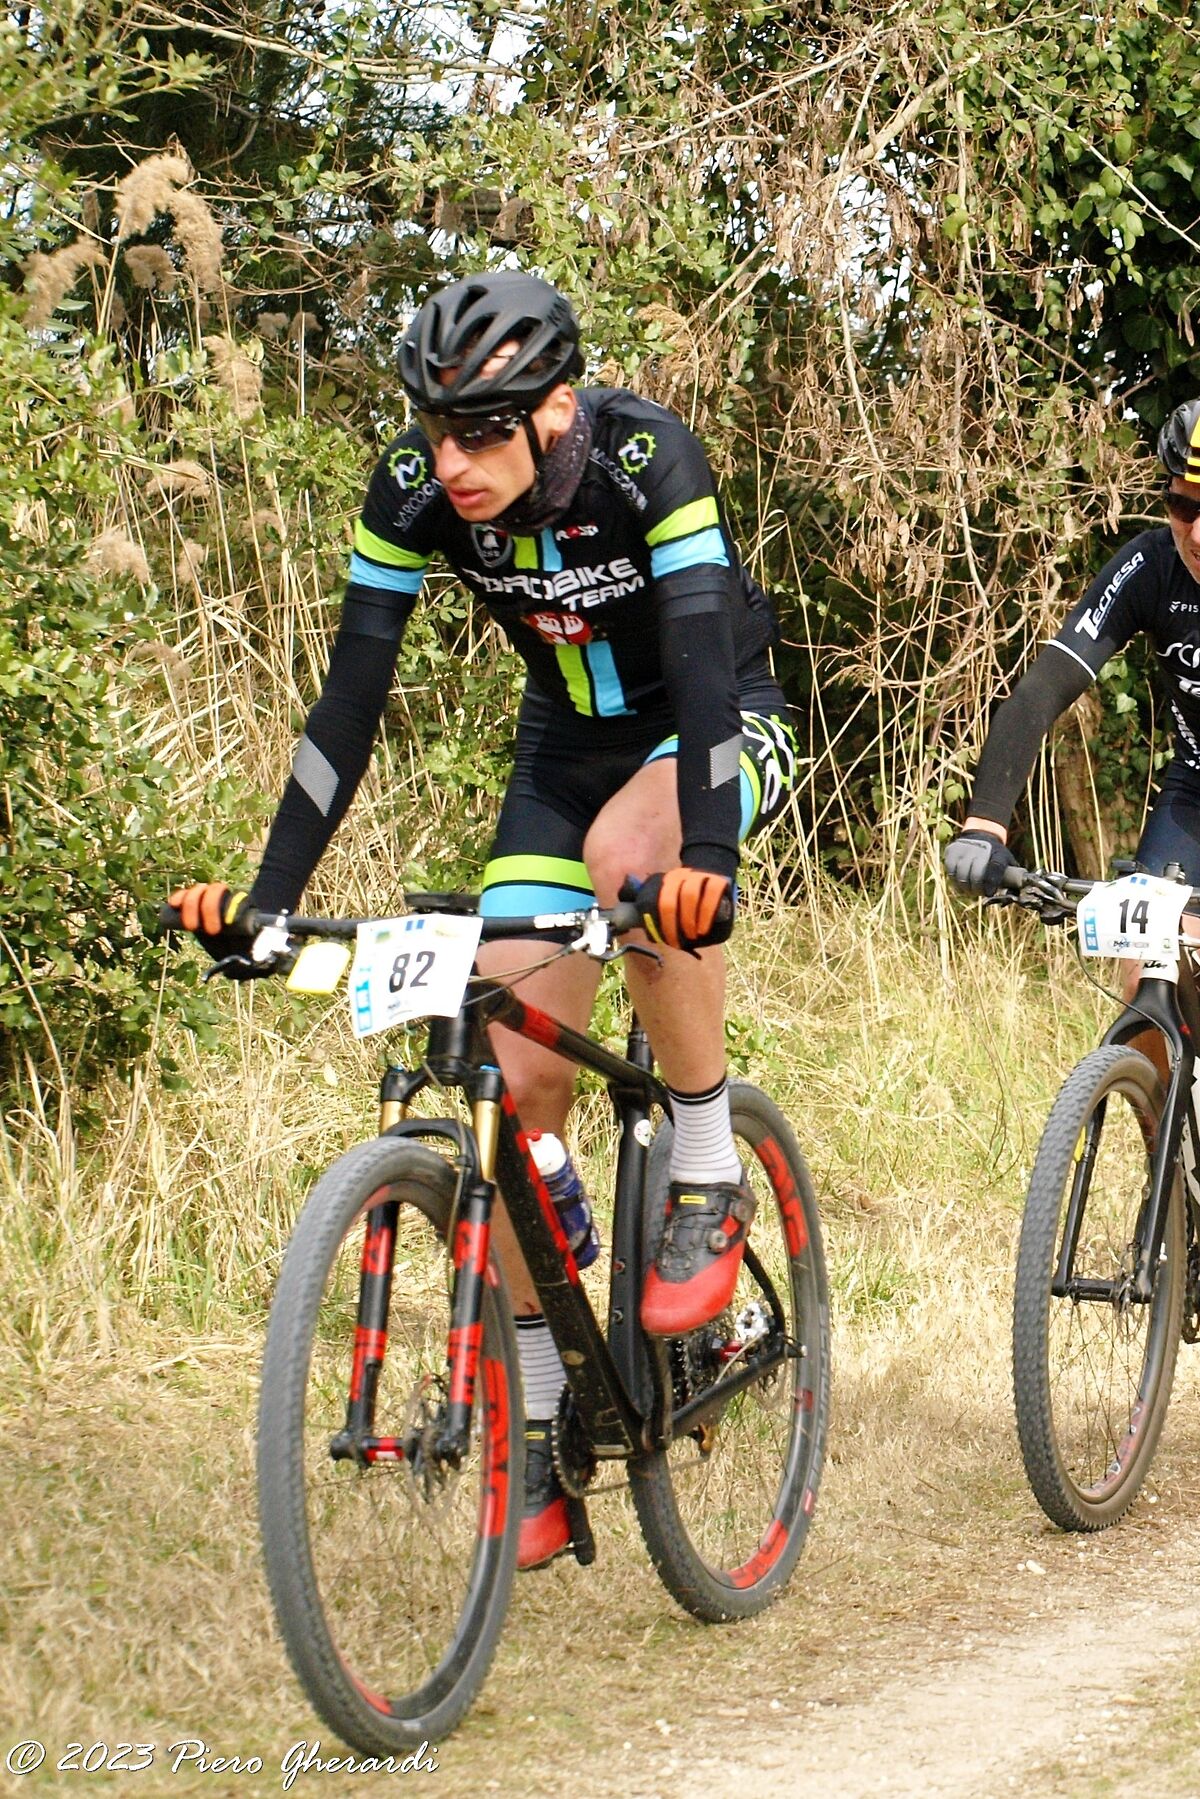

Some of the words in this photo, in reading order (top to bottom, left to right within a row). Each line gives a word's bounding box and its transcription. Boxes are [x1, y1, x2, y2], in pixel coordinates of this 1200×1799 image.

[561, 576, 645, 611] TEAM
[1119, 898, 1150, 934] 14
[389, 950, 436, 993] 82
